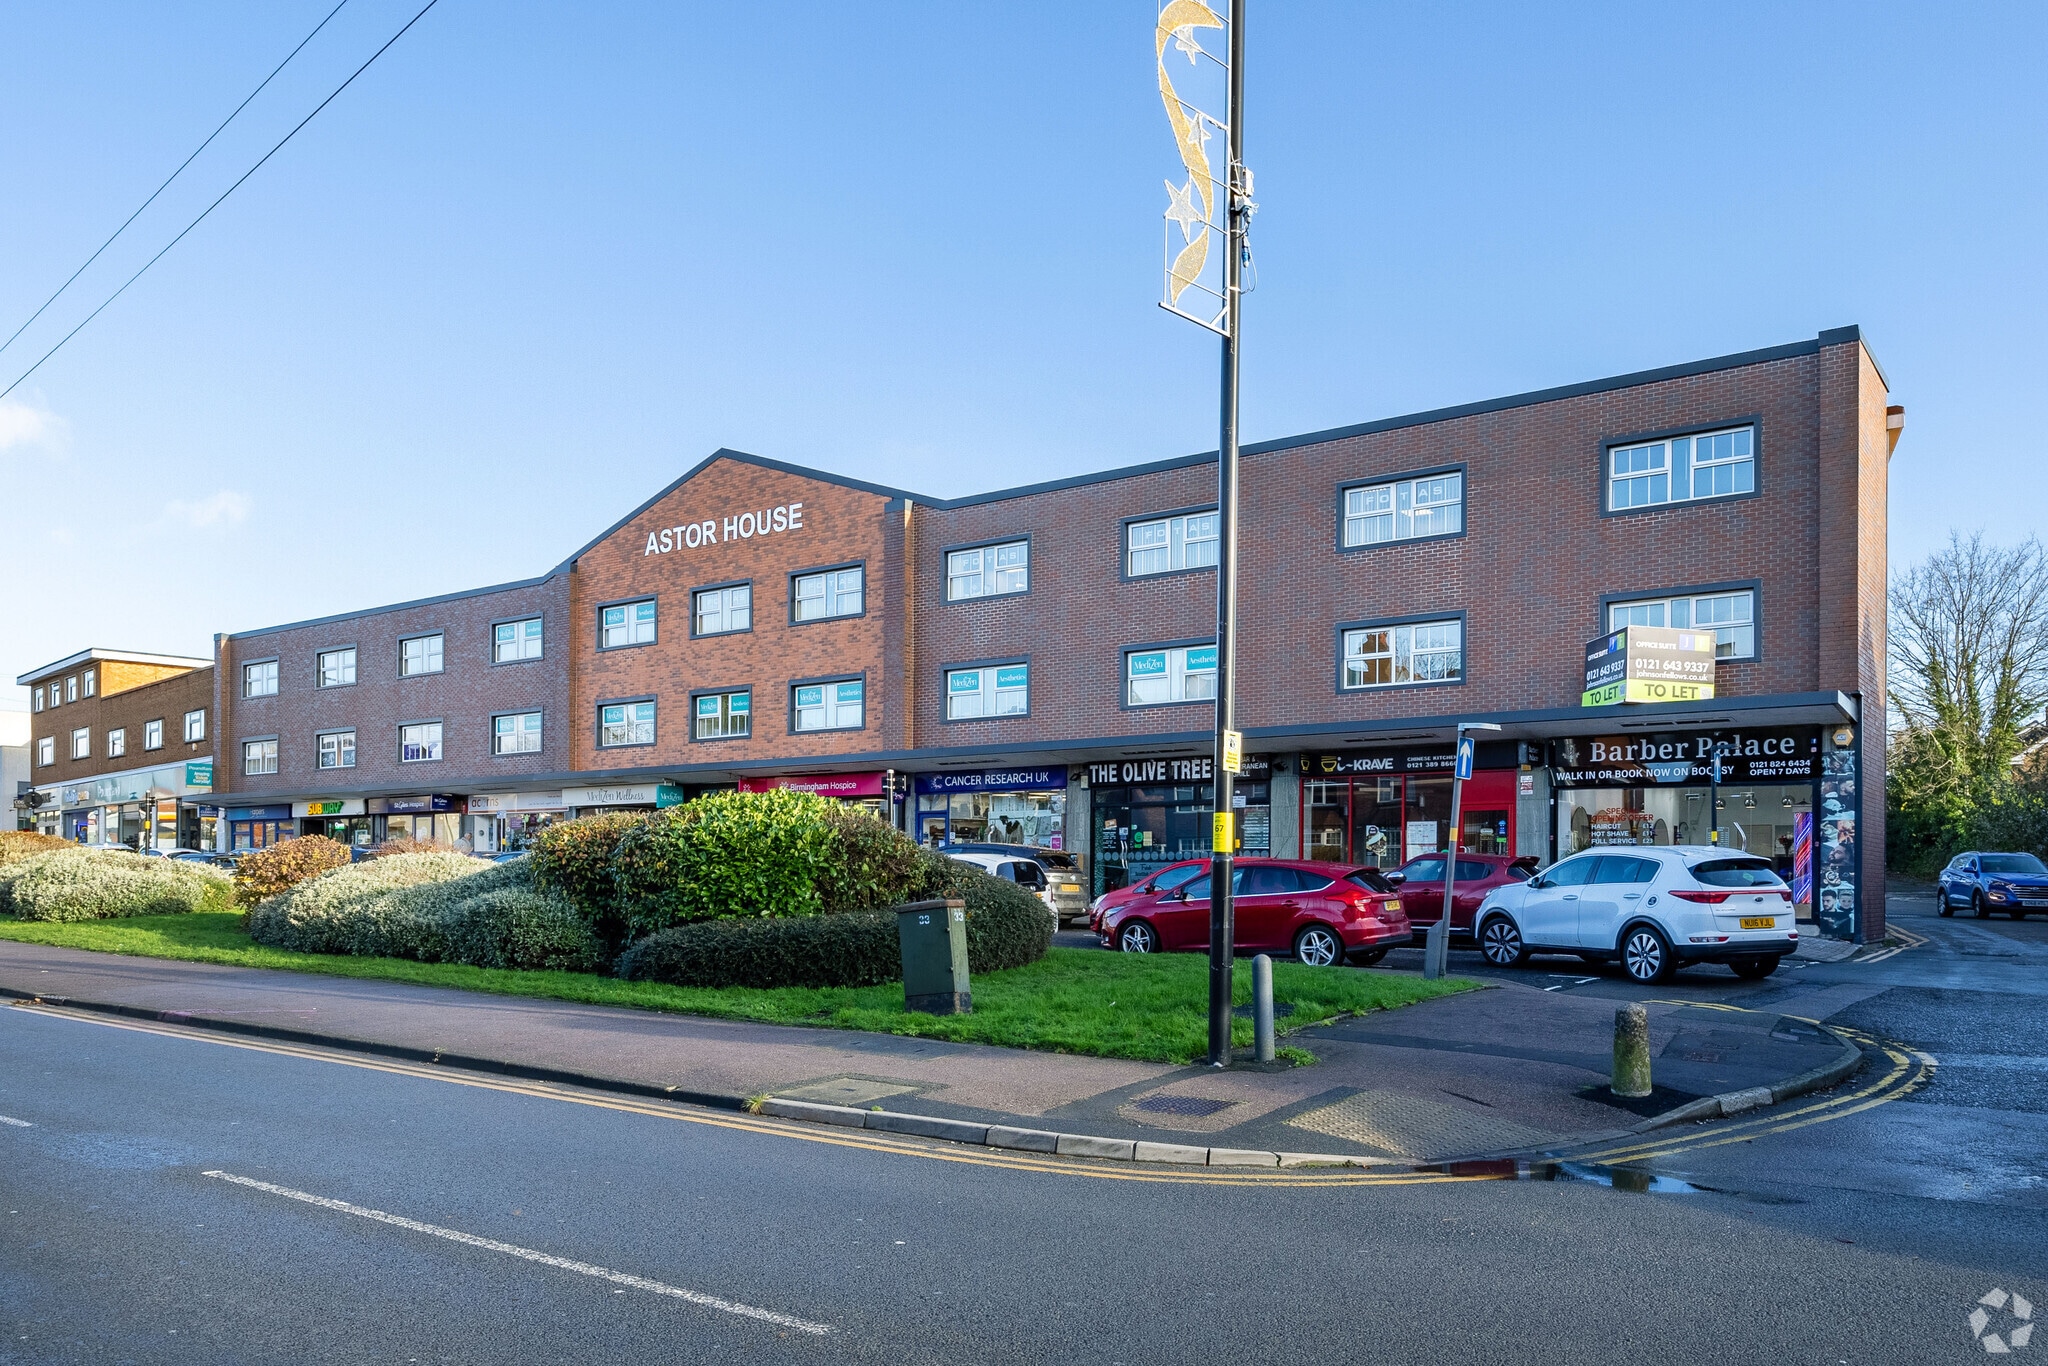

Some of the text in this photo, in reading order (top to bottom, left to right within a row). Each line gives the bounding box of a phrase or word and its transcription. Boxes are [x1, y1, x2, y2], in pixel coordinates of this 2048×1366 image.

[644, 502, 803, 556] ASTOR HOUSE
[1658, 642, 1677, 650] SUITE
[1134, 658, 1163, 670] MediZen
[1189, 655, 1217, 664] Aesthetic
[1635, 658, 1709, 673] 0121 643 9337
[1587, 659, 1625, 681] 0121 643 9337
[1636, 670, 1708, 681] johnsonfellows.co.uk
[1590, 685, 1618, 705] TO LET
[1644, 684, 1699, 699] TO LET
[1589, 734, 1796, 762] Barber Palace
[1241, 762, 1268, 770] RANEAN
[1788, 759, 1811, 767] 6434
[1089, 759, 1211, 783] THE OLIVE TREE
[1556, 766, 1734, 781] WALK IN OR BOOK NOW ON BOOSY
[1749, 768, 1776, 776] OPEN
[1785, 767, 1811, 775] DAYS
[944, 771, 1049, 787] CANCER RESEARCH UK
[790, 781, 857, 792] Birmingham Hospice
[616, 788, 645, 801] Wellness
[307, 801, 344, 816] SUBWAY
[1215, 825, 1224, 833] 67
[953, 912, 964, 922] 33
[1744, 918, 1772, 927] NU16 VJL
